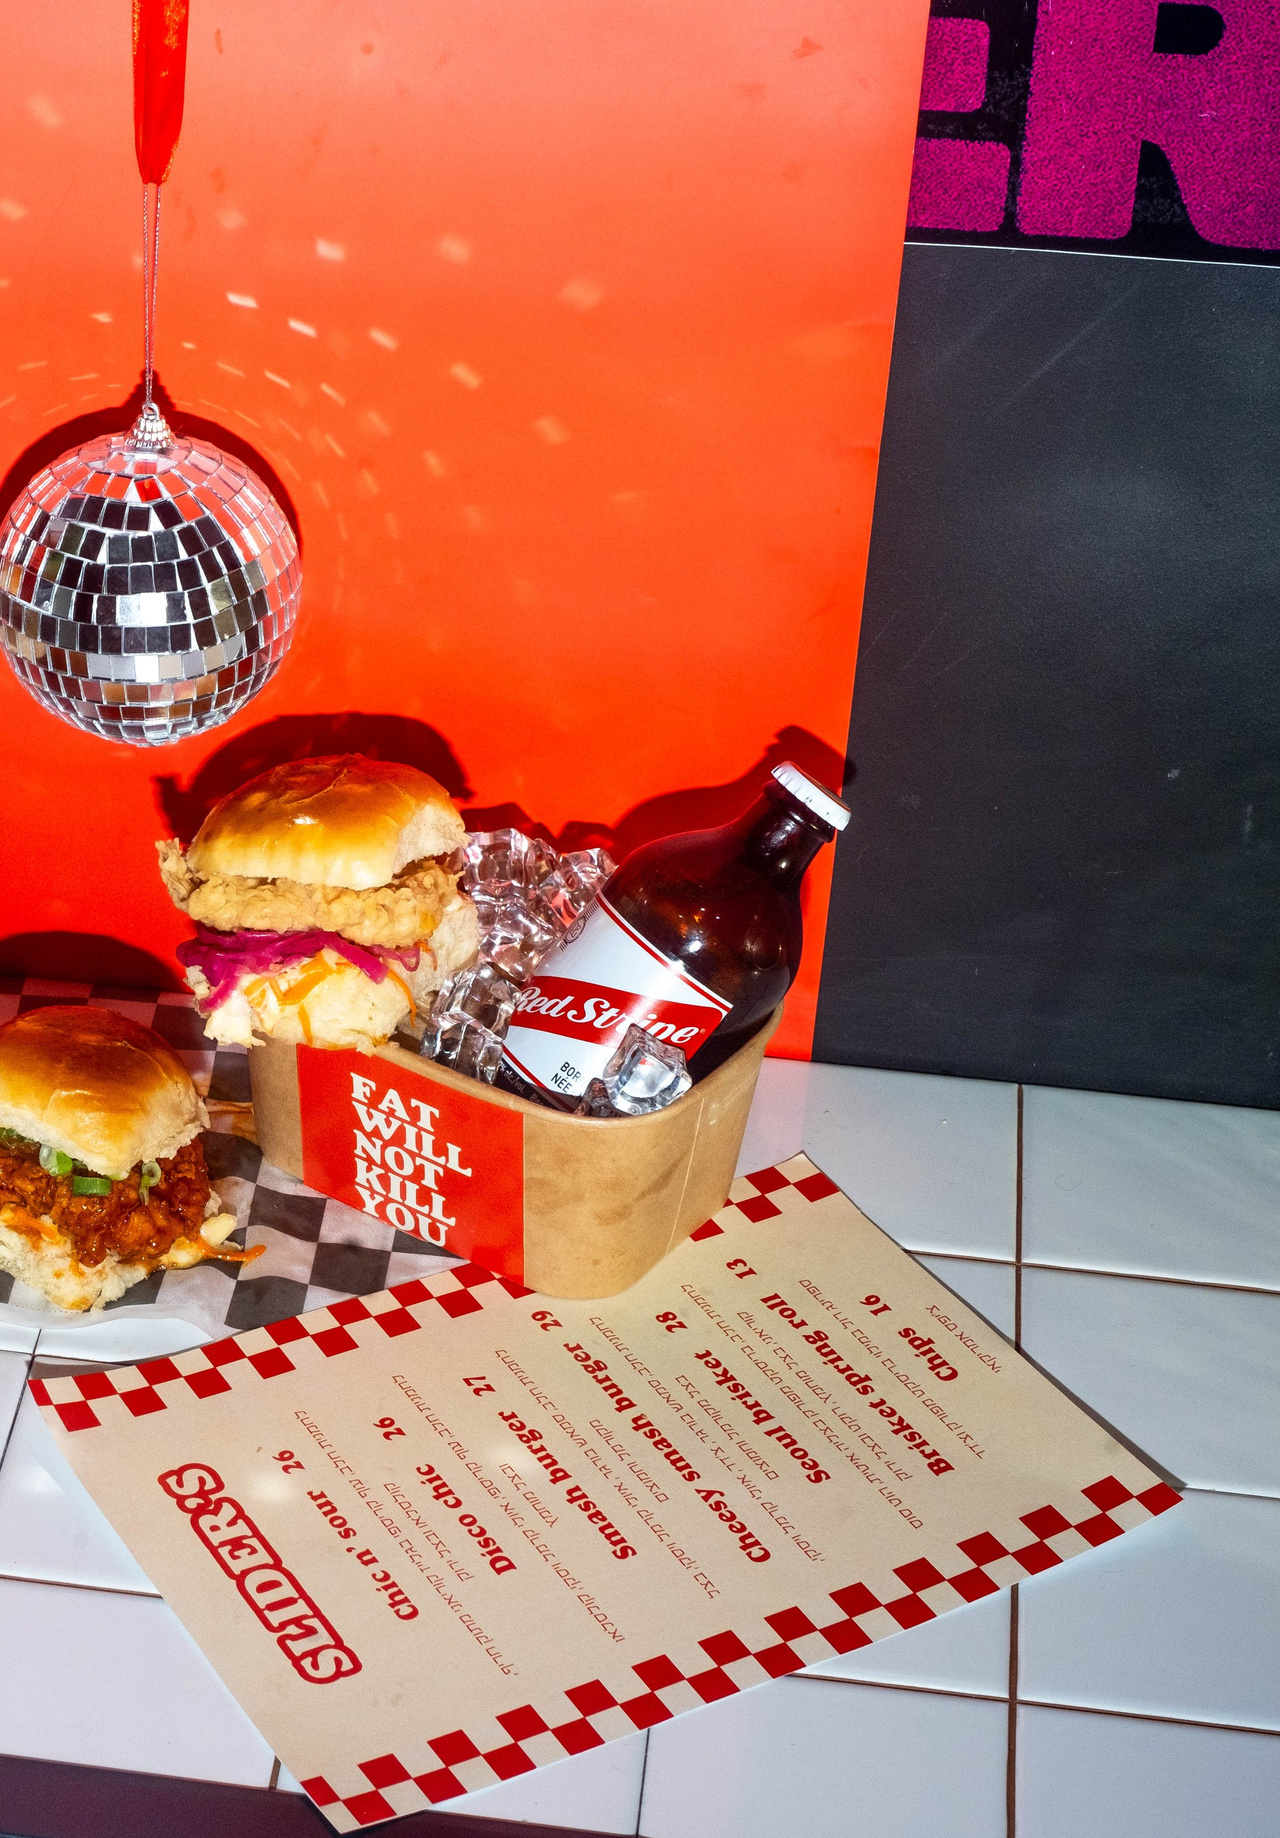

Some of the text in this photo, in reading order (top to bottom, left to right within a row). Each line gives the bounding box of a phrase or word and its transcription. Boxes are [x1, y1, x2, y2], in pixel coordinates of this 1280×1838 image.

[517, 987, 571, 1018] Red
[350, 1072, 439, 1132] FAT
[352, 1101, 472, 1177] WILL
[353, 1129, 443, 1190] NOT
[355, 1157, 455, 1226] KILL
[355, 1185, 448, 1246] YOU
[725, 1258, 954, 1476] Brisket spring roll 13
[859, 1294, 958, 1381] Chips 16
[655, 1311, 831, 1483] Seoul brisket 28
[272, 1449, 305, 1474] 26
[462, 1376, 637, 1559] Smash burger 27
[531, 1310, 770, 1562] Cheesy smash burger 29
[306, 1490, 356, 1539] sour
[372, 1416, 516, 1575] Disco chic 26
[157, 1462, 362, 1684] SLIDER'S
[371, 1570, 419, 1620] Chic
